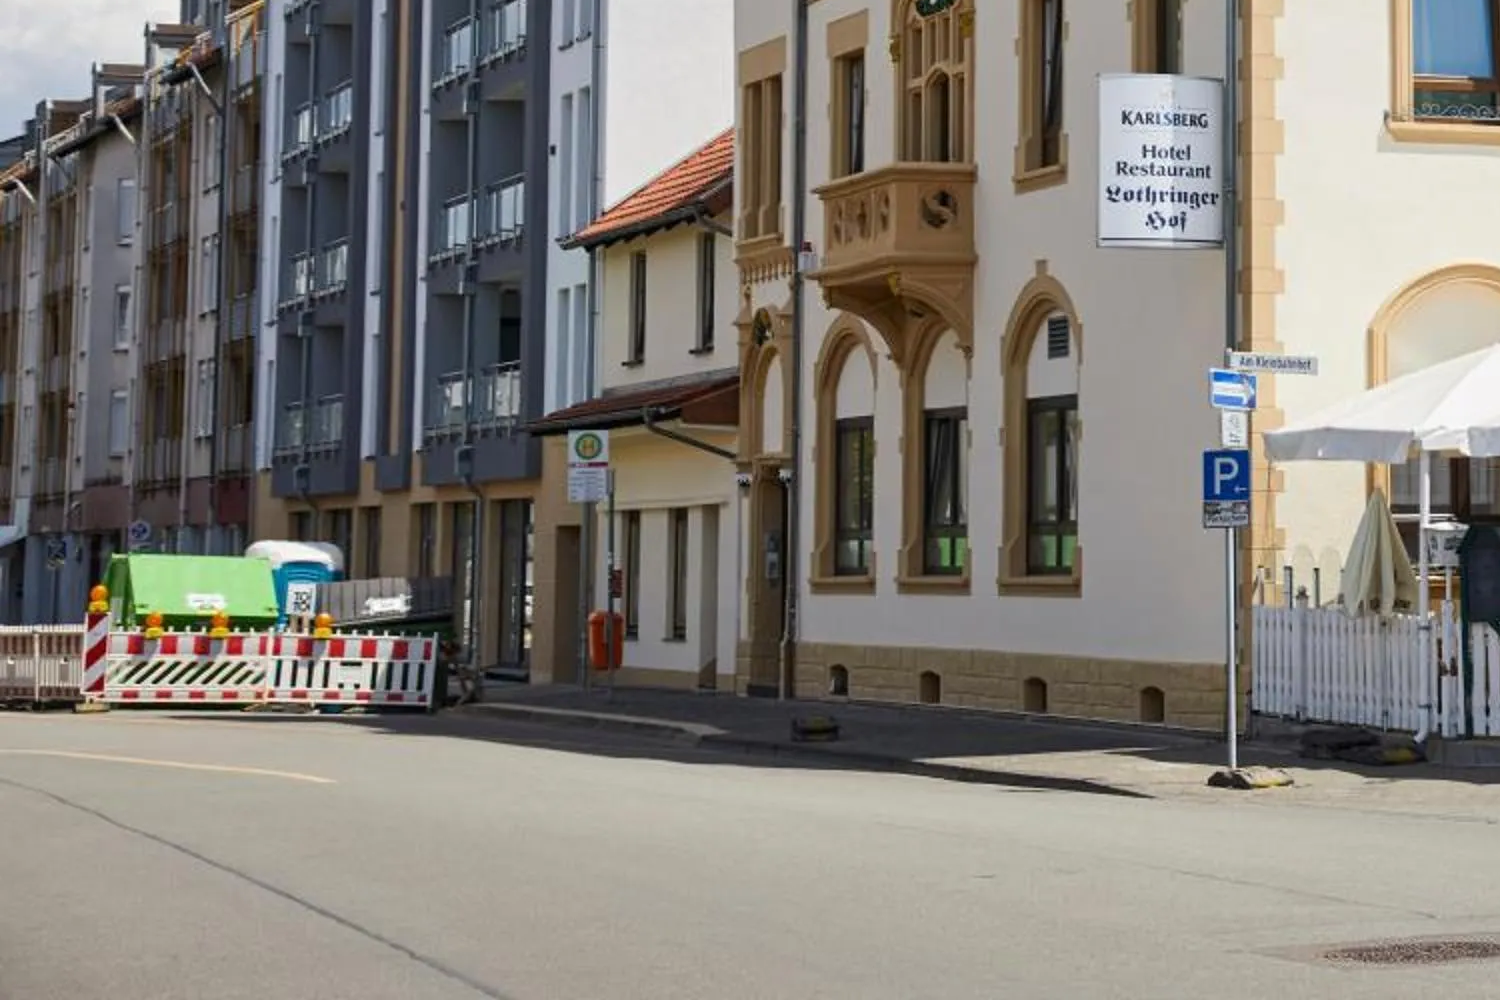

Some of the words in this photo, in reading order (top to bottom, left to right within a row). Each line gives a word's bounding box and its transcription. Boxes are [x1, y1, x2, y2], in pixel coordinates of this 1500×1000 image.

[1121, 109, 1209, 128] KARLSBERG
[1142, 144, 1191, 160] Hotel
[1116, 160, 1211, 179] Restaurant
[1105, 185, 1219, 209] Lothringer
[1145, 211, 1187, 232] Hof
[1214, 457, 1239, 495] P
